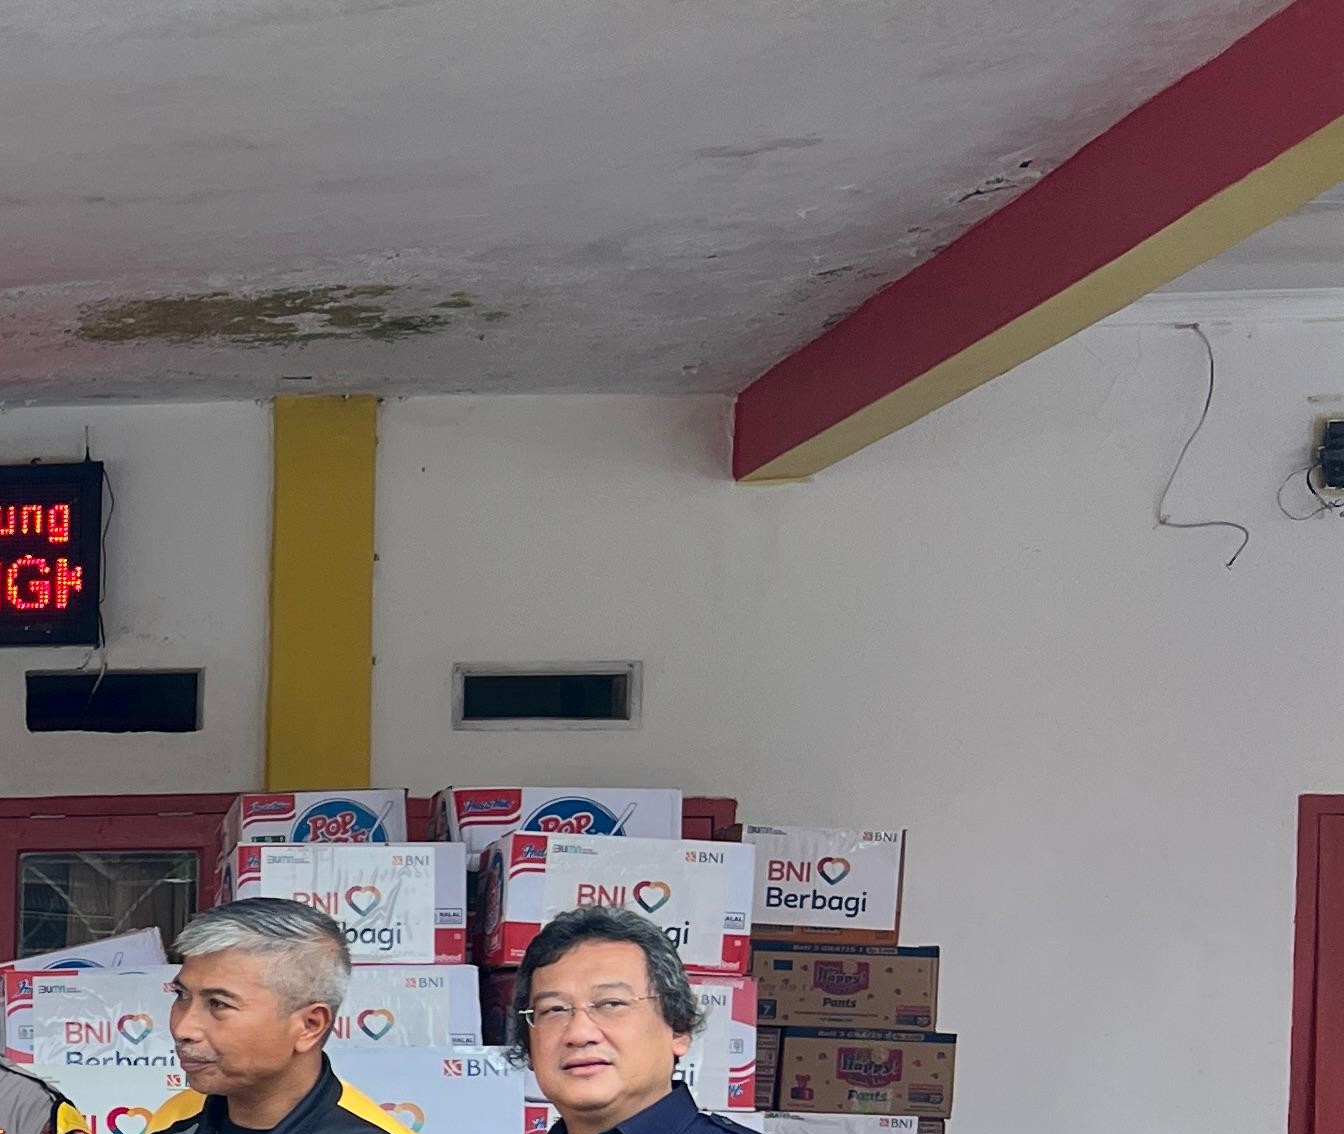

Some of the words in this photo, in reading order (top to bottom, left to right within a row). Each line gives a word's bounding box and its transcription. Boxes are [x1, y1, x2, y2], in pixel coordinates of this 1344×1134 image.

[308, 811, 357, 842] POP
[874, 831, 898, 843] BNI
[405, 855, 430, 866] BNI
[698, 851, 725, 864] BNI
[767, 859, 811, 883] BNI
[577, 883, 627, 908] BNI
[766, 886, 867, 919] Berbagi
[341, 921, 402, 951] bagi
[419, 977, 444, 988] BNI
[701, 994, 727, 1006] BNI
[822, 997, 857, 1009] Pants
[65, 1021, 111, 1044] BNI
[332, 1015, 350, 1040] NI
[890, 1118, 913, 1129] BNI
